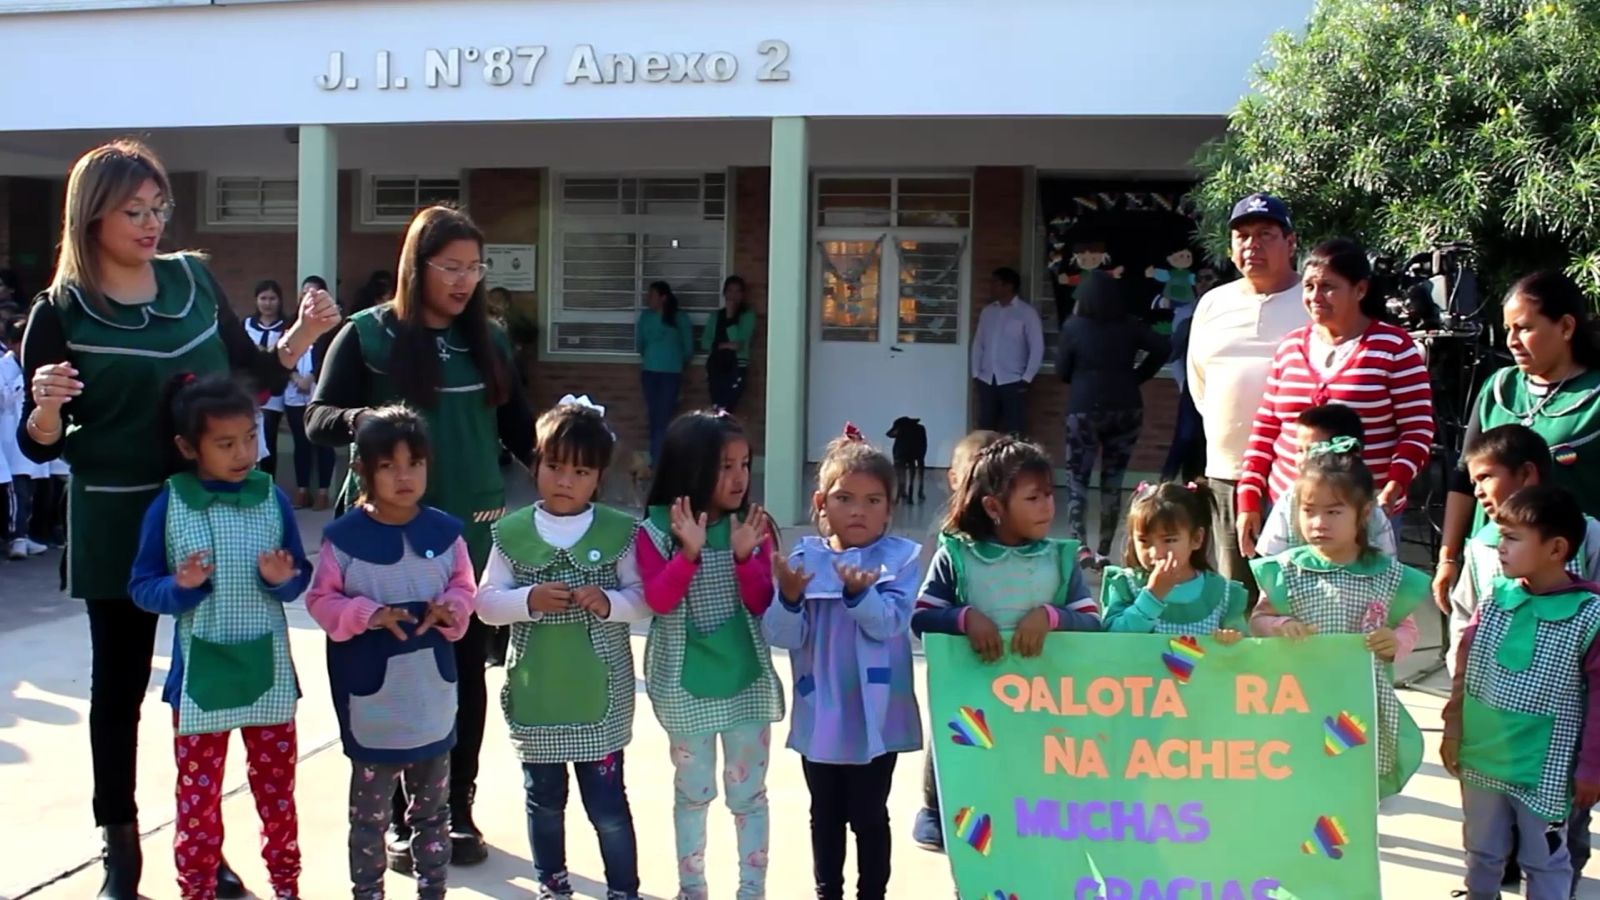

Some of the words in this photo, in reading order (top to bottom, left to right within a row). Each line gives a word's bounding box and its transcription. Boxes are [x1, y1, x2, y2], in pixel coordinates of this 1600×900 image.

[314, 50, 358, 91] J.
[376, 50, 407, 90] I.
[564, 43, 738, 85] Anexo
[756, 39, 790, 83] 2
[992, 673, 1188, 718] QALOTA
[1235, 673, 1311, 715] RA
[1124, 738, 1293, 780] ACHEC
[1014, 796, 1210, 843] MUCHAS
